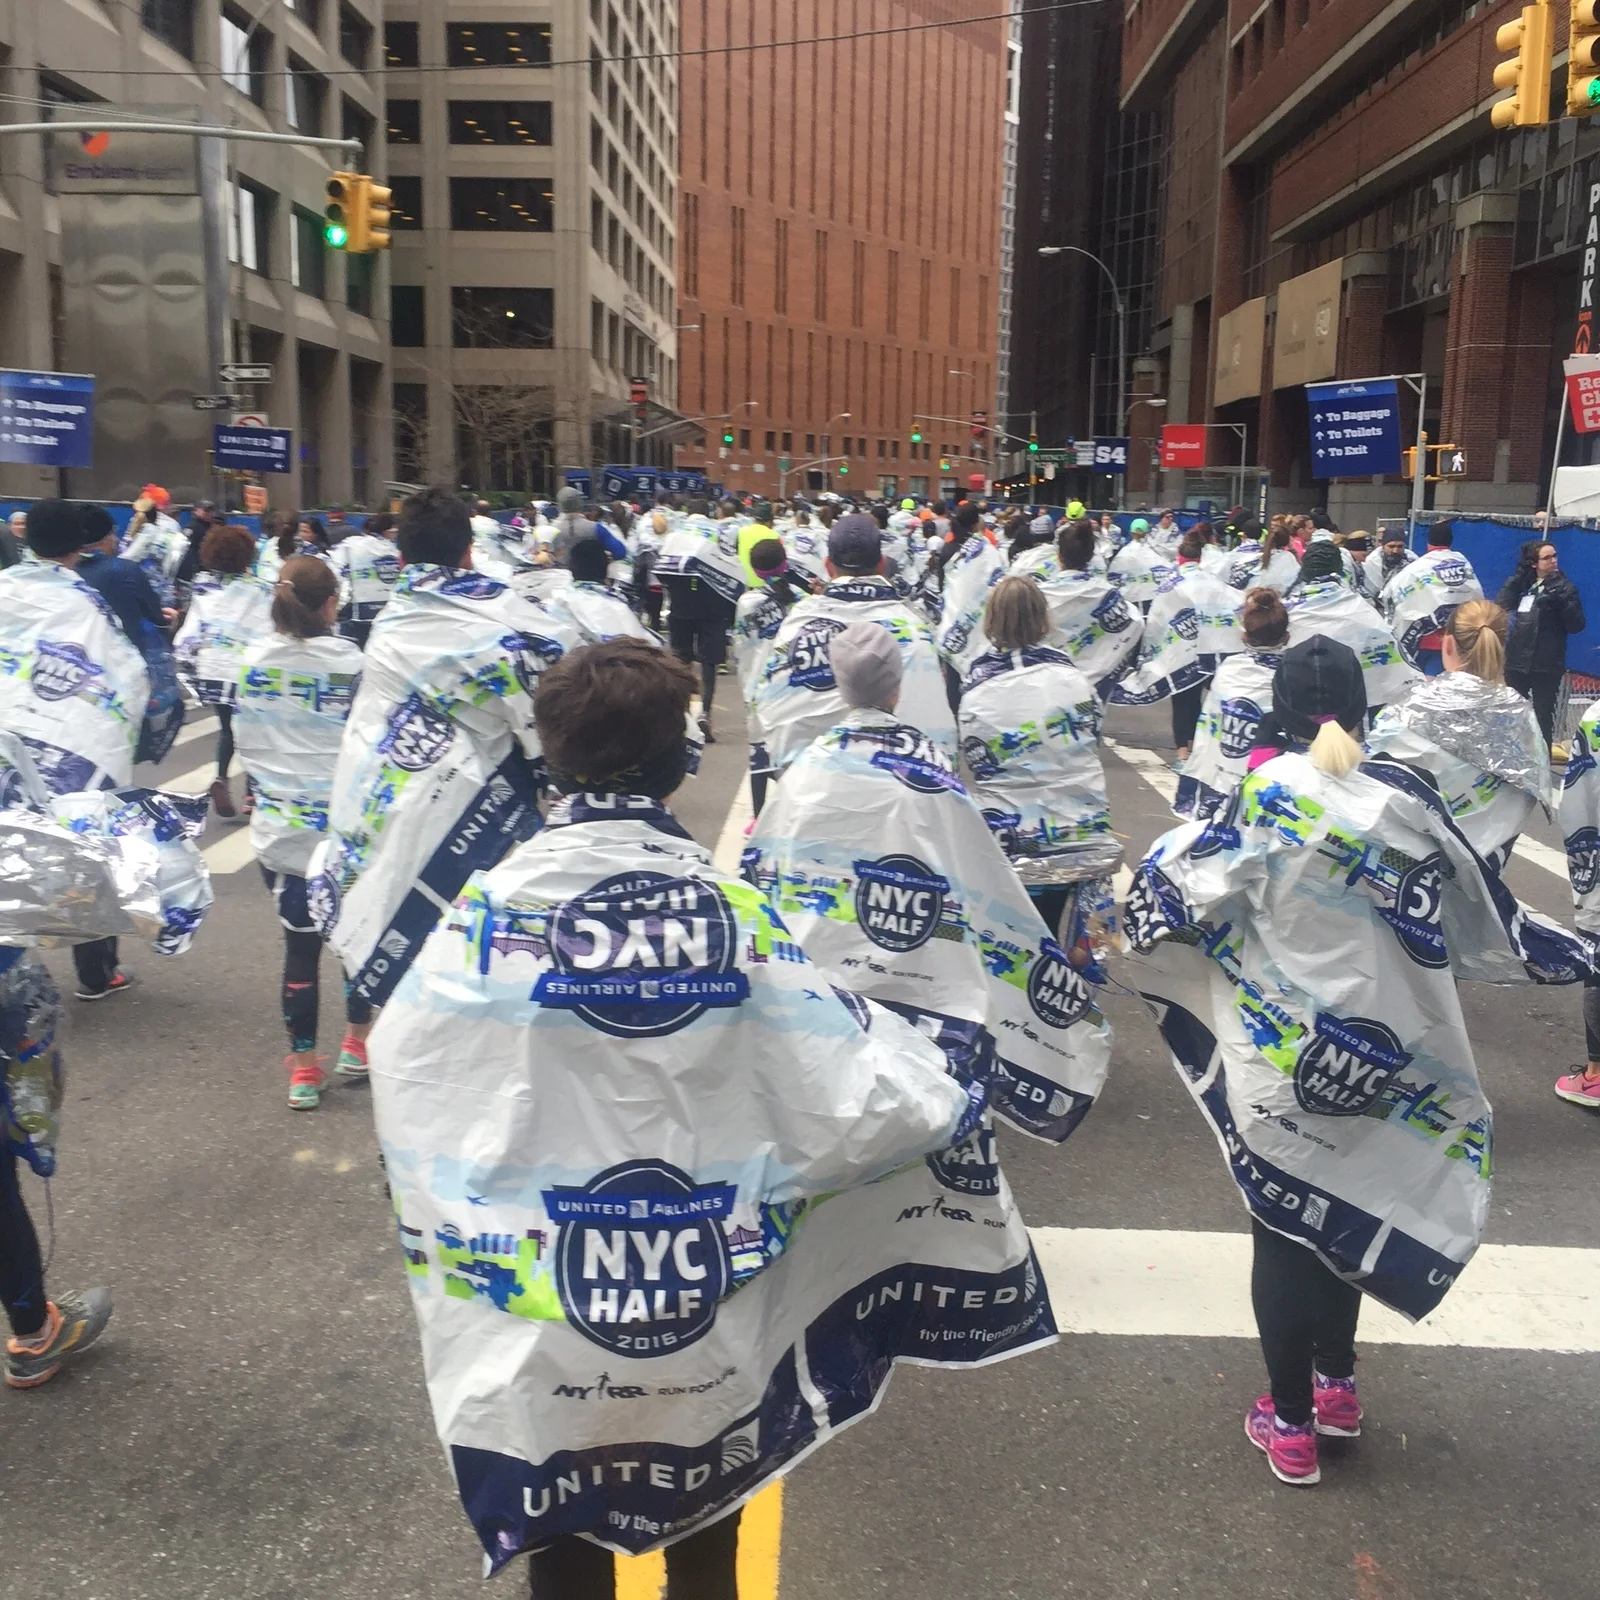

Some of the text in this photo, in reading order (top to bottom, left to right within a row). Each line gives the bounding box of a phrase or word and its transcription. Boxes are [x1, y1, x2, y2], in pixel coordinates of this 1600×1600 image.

[1580, 183, 1600, 308] PARK
[1326, 408, 1391, 422] To Baggage
[1327, 426, 1383, 440] To Toilets
[1095, 446, 1127, 465] S4
[1167, 442, 1201, 450] Medical
[1328, 444, 1368, 457] To Exit
[637, 477, 651, 489] 2
[1439, 567, 1464, 578] NYC
[795, 646, 831, 671] YC
[893, 732, 954, 773] NYC
[867, 881, 932, 918] NYC
[868, 910, 924, 936] HALF
[1384, 913, 1431, 940] AIRLINES
[573, 918, 708, 969] NYC
[546, 981, 737, 996] UNITED AIRLINES
[1036, 985, 1082, 1016] HALF
[1320, 1021, 1360, 1046] UNITED
[1313, 1042, 1389, 1096] NYC
[1303, 1072, 1366, 1109] HALF
[1225, 1121, 1301, 1211] NITED
[558, 1200, 628, 1216] UNITED
[583, 1228, 708, 1281] NYC
[588, 1288, 703, 1324] HALF
[855, 1280, 1018, 1321] UNITED
[615, 1331, 679, 1350] 2016
[919, 1329, 939, 1342] fly
[943, 1328, 966, 1341] the
[969, 1323, 1021, 1343] friendly
[657, 1386, 687, 1397] RUN
[522, 1460, 712, 1518] UNITED
[633, 1513, 661, 1536] the
